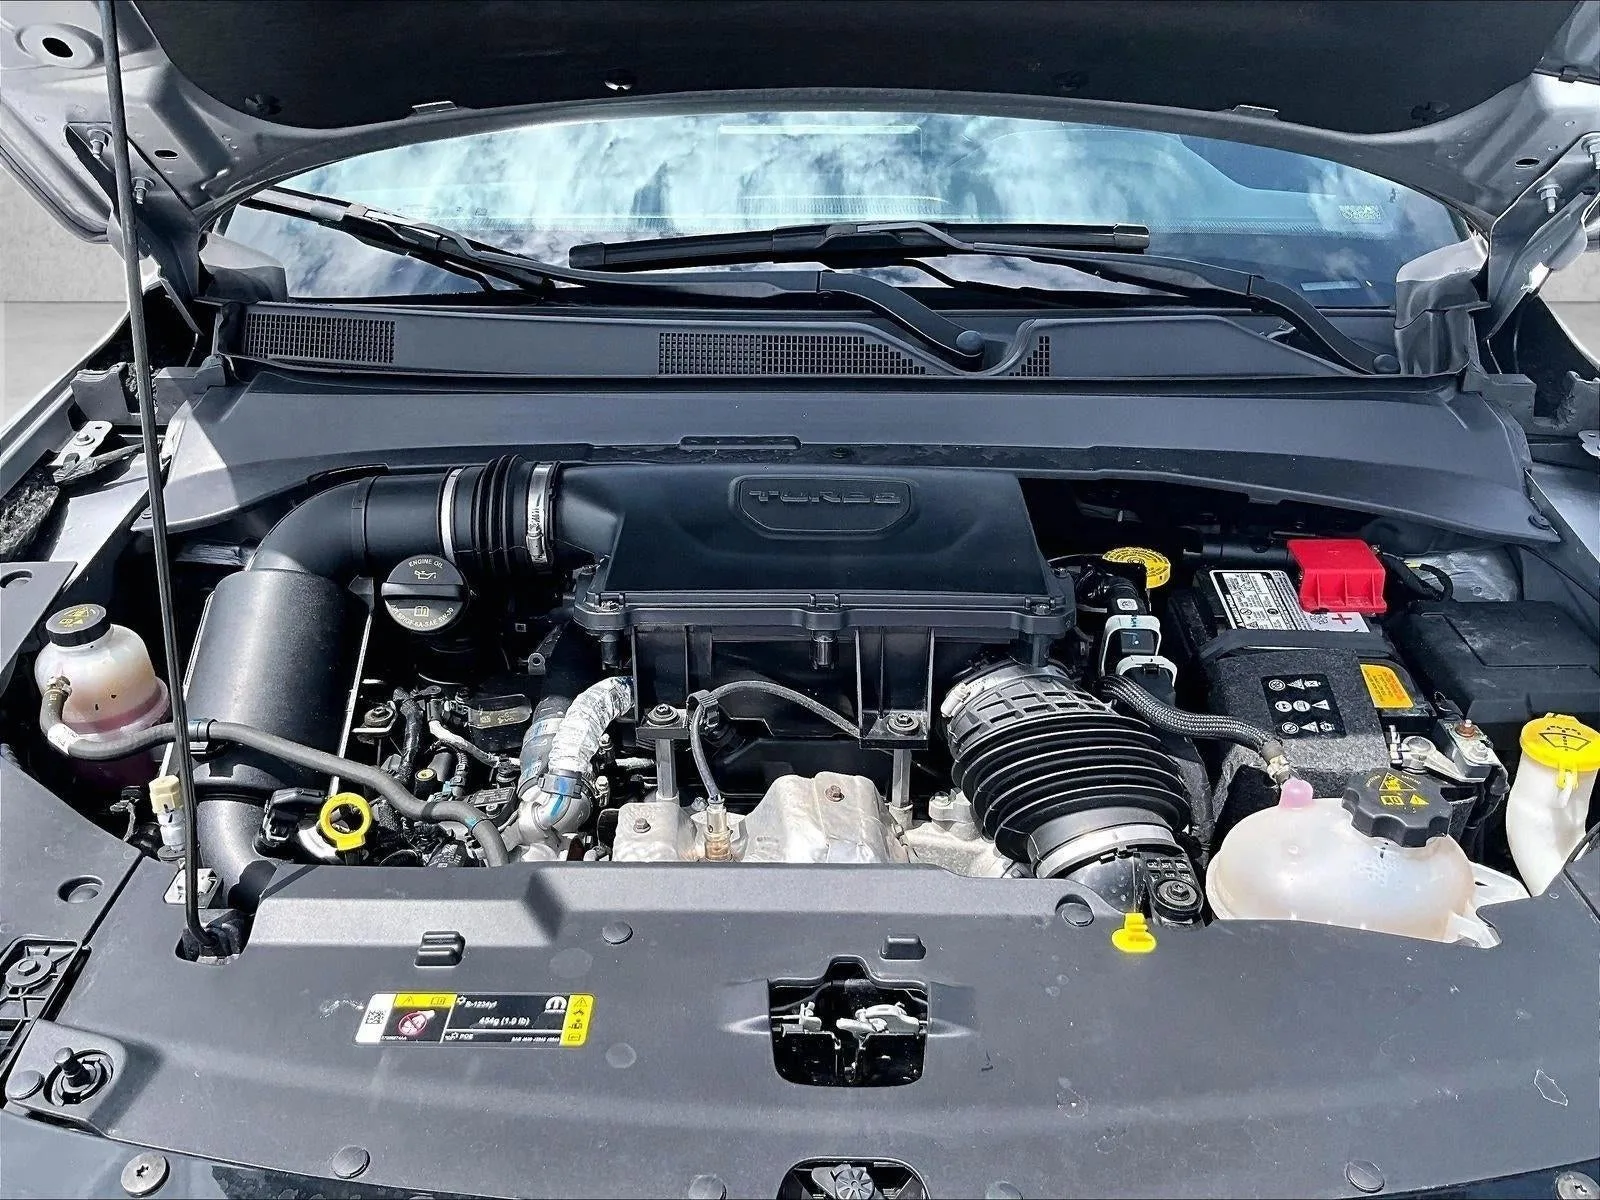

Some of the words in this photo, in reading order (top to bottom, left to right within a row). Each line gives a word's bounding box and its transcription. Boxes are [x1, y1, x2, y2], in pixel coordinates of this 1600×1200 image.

[749, 490, 901, 504] TURBO
[408, 559, 432, 567] ENGINE
[433, 560, 443, 569] OIL
[478, 1016, 500, 1027] 454g
